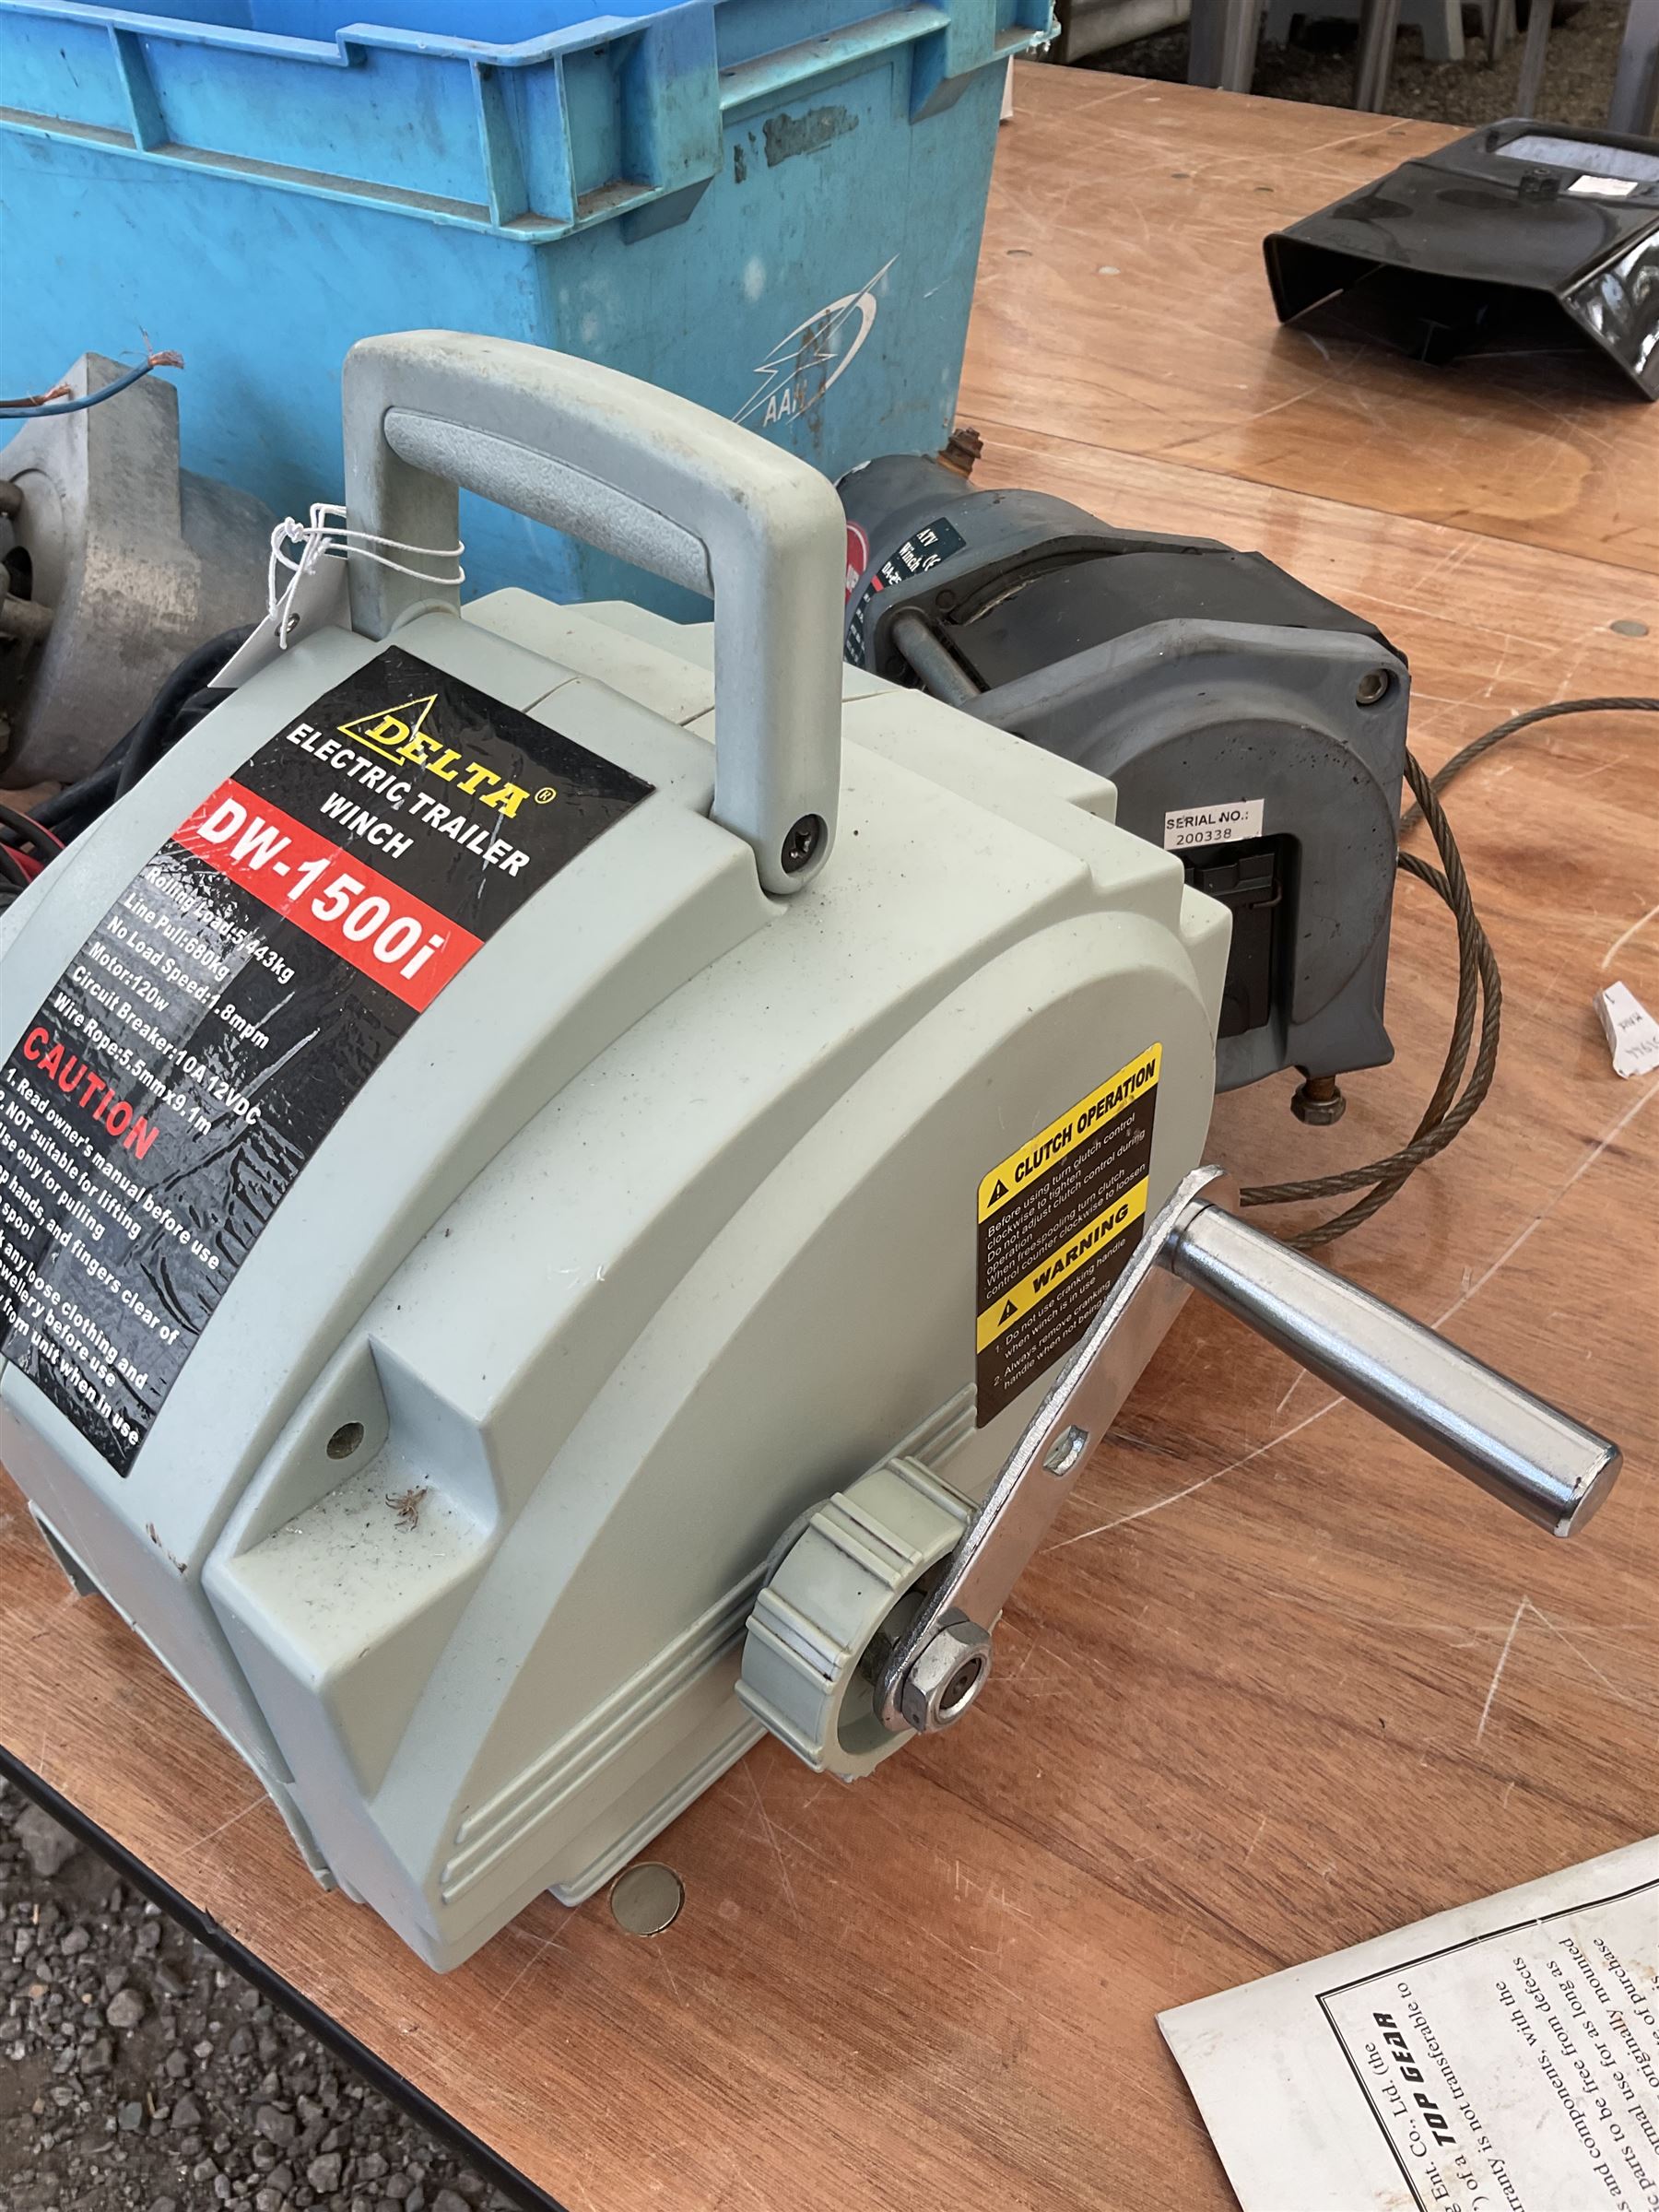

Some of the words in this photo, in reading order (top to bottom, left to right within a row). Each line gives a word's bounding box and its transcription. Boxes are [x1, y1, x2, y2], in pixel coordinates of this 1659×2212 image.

[899, 541, 923, 573] Winch
[916, 528, 938, 546] ATV
[286, 723, 411, 803] ELECTRIC
[408, 793, 531, 877] TRAILER
[365, 714, 530, 819] DELTA
[320, 792, 415, 859] WINCH
[1166, 814, 1216, 830] SERIAL
[1176, 829, 1232, 845] 200338
[146, 866, 195, 919] Rolling
[196, 798, 445, 980] DW-1500i
[124, 892, 155, 924] Line
[155, 914, 229, 982] Pull:680kg
[88, 941, 170, 1012] Motor:120w
[107, 915, 127, 940] No
[125, 931, 165, 968] Load
[161, 957, 271, 1050] Speed:1.8mpm
[53, 992, 85, 1028] Wire
[83, 1017, 213, 1136] Rope:5.5mmx9.1m
[72, 966, 121, 1012] Circuit
[114, 1001, 206, 1084] Breaker:10A
[207, 1077, 262, 1125] 12VDC
[23, 1027, 160, 1160] CAUTION
[1015, 1123, 1073, 1183] CLUTCH
[1077, 1058, 1156, 1134] OPERATION
[6, 1067, 17, 1087] 1.
[17, 1077, 52, 1114] Read
[46, 1110, 94, 1159] owner's
[92, 1152, 147, 1203] manual
[143, 1194, 191, 1242] before
[192, 1241, 220, 1270] use
[6, 1100, 34, 1133] NOT
[30, 1127, 78, 1179] suitable
[77, 1171, 99, 1198] for
[97, 1190, 143, 1240] lifting
[17, 1148, 43, 1180] only
[41, 1169, 63, 1196] for
[58, 1191, 106, 1241] pulling
[987, 1247, 1002, 1263] Do
[1004, 1230, 1019, 1249] not
[1021, 1205, 1052, 1234] adjust
[1053, 1181, 1081, 1208] clutch
[1083, 1152, 1115, 1183] control
[1117, 1129, 1146, 1157] during
[988, 1206, 1021, 1238] Before
[1023, 1183, 1051, 1209] using
[1052, 1166, 1071, 1185] turn
[1073, 1140, 1101, 1168] clutch
[1103, 1112, 1135, 1145] control
[2, 1202, 36, 1241] spool
[986, 1260, 1015, 1287] When
[1018, 1209, 1076, 1262] freespooling
[1077, 1193, 1096, 1211] turn
[1098, 1169, 1125, 1195] clutch
[986, 1265, 1019, 1300] control
[1021, 1236, 1057, 1270] counter
[1059, 1197, 1104, 1238] clockwise
[1105, 1189, 1115, 1201] to
[1116, 1163, 1146, 1192] loosen
[987, 1207, 1035, 1251] clockwise
[1037, 1197, 1047, 1209] to
[1049, 1170, 1082, 1200] tighten
[8, 1175, 46, 1226] hands,
[46, 1218, 73, 1246] and
[71, 1239, 122, 1294] fingers
[122, 1289, 160, 1328] clear
[160, 1324, 181, 1346] of
[986, 1233, 1033, 1276] operation
[1032, 1203, 1129, 1294] WARNING
[4, 1242, 27, 1272] any
[25, 1262, 61, 1306] loose
[62, 1301, 120, 1364] clothing
[118, 1359, 149, 1390] and
[1005, 1335, 1030, 1359] when
[1031, 1309, 1058, 1335] winch
[1060, 1300, 1068, 1312] is
[1069, 1291, 1078, 1303] in
[1079, 1277, 1096, 1296] use
[1006, 1331, 1019, 1346] Do
[1021, 1316, 1037, 1332] not
[1038, 1300, 1054, 1316] use
[1056, 1264, 1095, 1300] cranking
[1096, 1238, 1126, 1268] handle
[45, 1309, 90, 1360] before
[89, 1356, 117, 1388] use
[994, 1376, 1003, 1386] 2.
[1004, 1345, 1037, 1378] Always
[1038, 1314, 1072, 1347] remove
[1074, 1280, 1111, 1316] cranking
[1004, 1359, 1035, 1390] handle
[1037, 1337, 1061, 1360] when
[1062, 1321, 1077, 1337] not
[1078, 1300, 1102, 1324] being
[3, 1298, 29, 1336] from
[31, 1329, 61, 1365] unit
[60, 1359, 98, 1404] when
[95, 1396, 113, 1418] in
[112, 1413, 139, 1446] use
[1397, 1982, 1412, 1999] to
[1495, 1981, 1516, 2007] the
[1512, 1957, 1551, 2013] defects
[1547, 1959, 1563, 1979] as
[1558, 1937, 1611, 2004] mounted
[1559, 1980, 1586, 2018] long
[1593, 1937, 1647, 2005] purchase
[1372, 2012, 1425, 2083] GEAR
[1407, 2001, 1465, 2100] transferable
[1511, 2009, 1538, 2047] with
[1547, 2016, 1577, 2057] from
[1583, 2019, 1599, 2040] as
[1606, 2009, 1659, 2088] originally
[1633, 2008, 1655, 2026] of
[1365, 2041, 1390, 2076] (the
[1573, 2059, 1600, 2094] free
[1594, 2041, 1617, 2067] for
[1613, 2070, 1635, 2100] use
[1381, 2079, 1408, 2118] Ltd.
[1414, 2092, 1456, 2147] TOP
[1460, 2101, 1482, 2132] not
[1537, 2049, 1601, 2159] components,
[1594, 2098, 1613, 2122] be
[1408, 2118, 1428, 2158] Co.,
[1454, 2154, 1466, 2166] a
[1477, 2136, 1492, 2153] is
[1609, 2124, 1625, 2143] to
[1426, 2161, 1450, 2201] Ent.
[1456, 2171, 1477, 2191] of
[1593, 2162, 1622, 2197] and
[1621, 2145, 1655, 2190] parts
